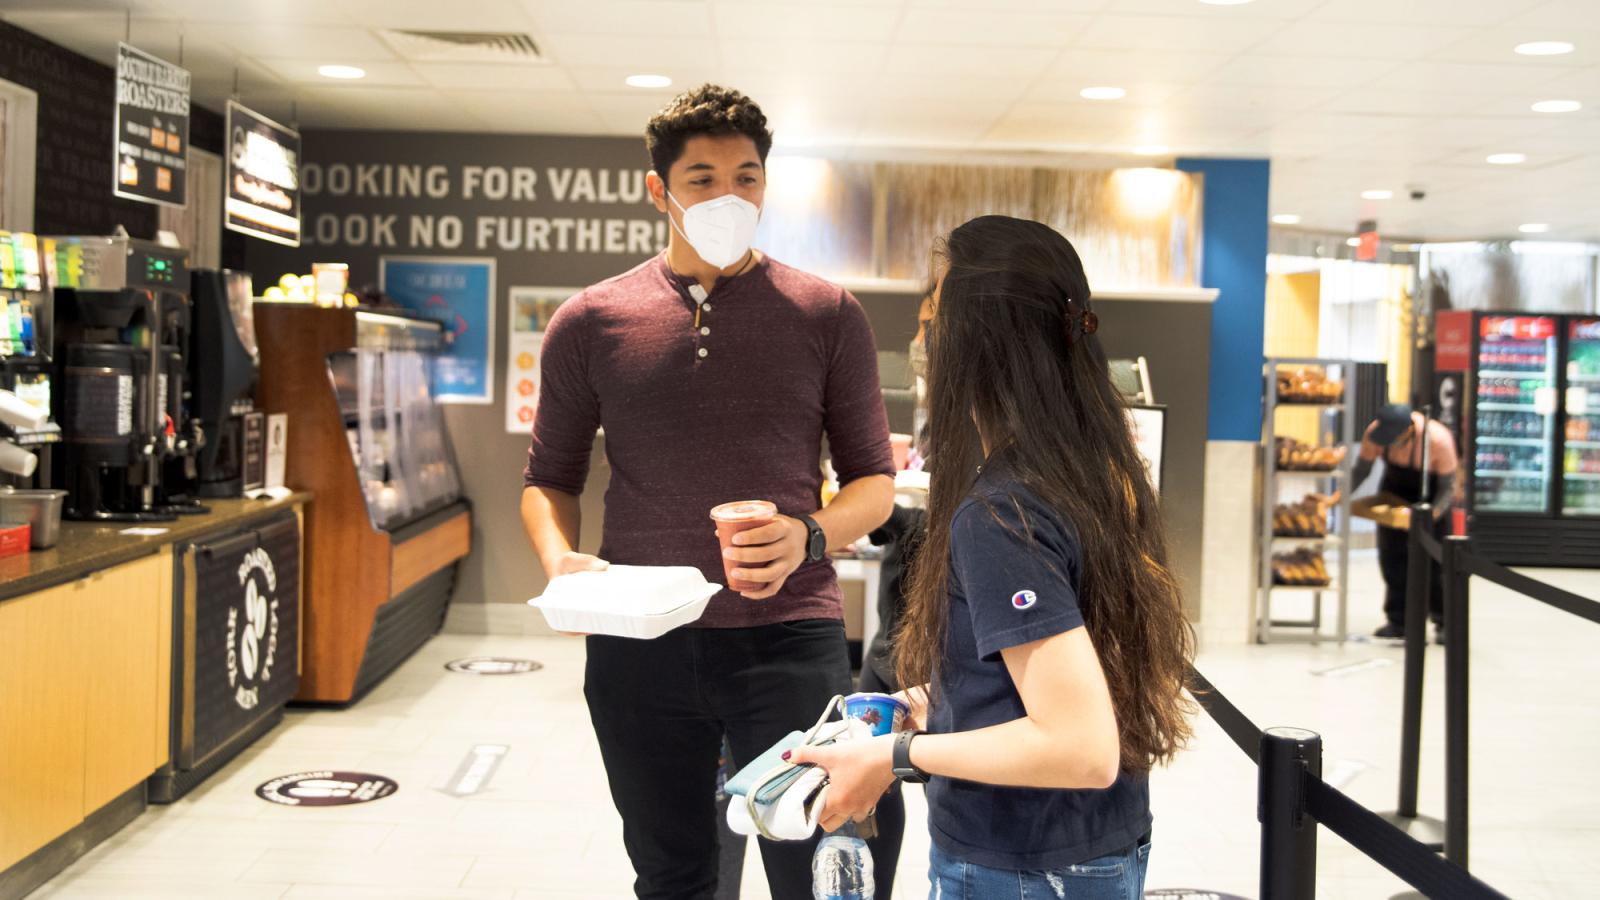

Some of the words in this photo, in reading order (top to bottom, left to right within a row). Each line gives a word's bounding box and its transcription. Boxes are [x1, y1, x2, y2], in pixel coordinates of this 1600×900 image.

[117, 79, 190, 116] ROASTERS
[301, 163, 450, 199] OOKING
[462, 165, 537, 201] FOR
[546, 167, 655, 204] VALU
[409, 215, 463, 249] NO
[476, 216, 666, 254] FURTHER!
